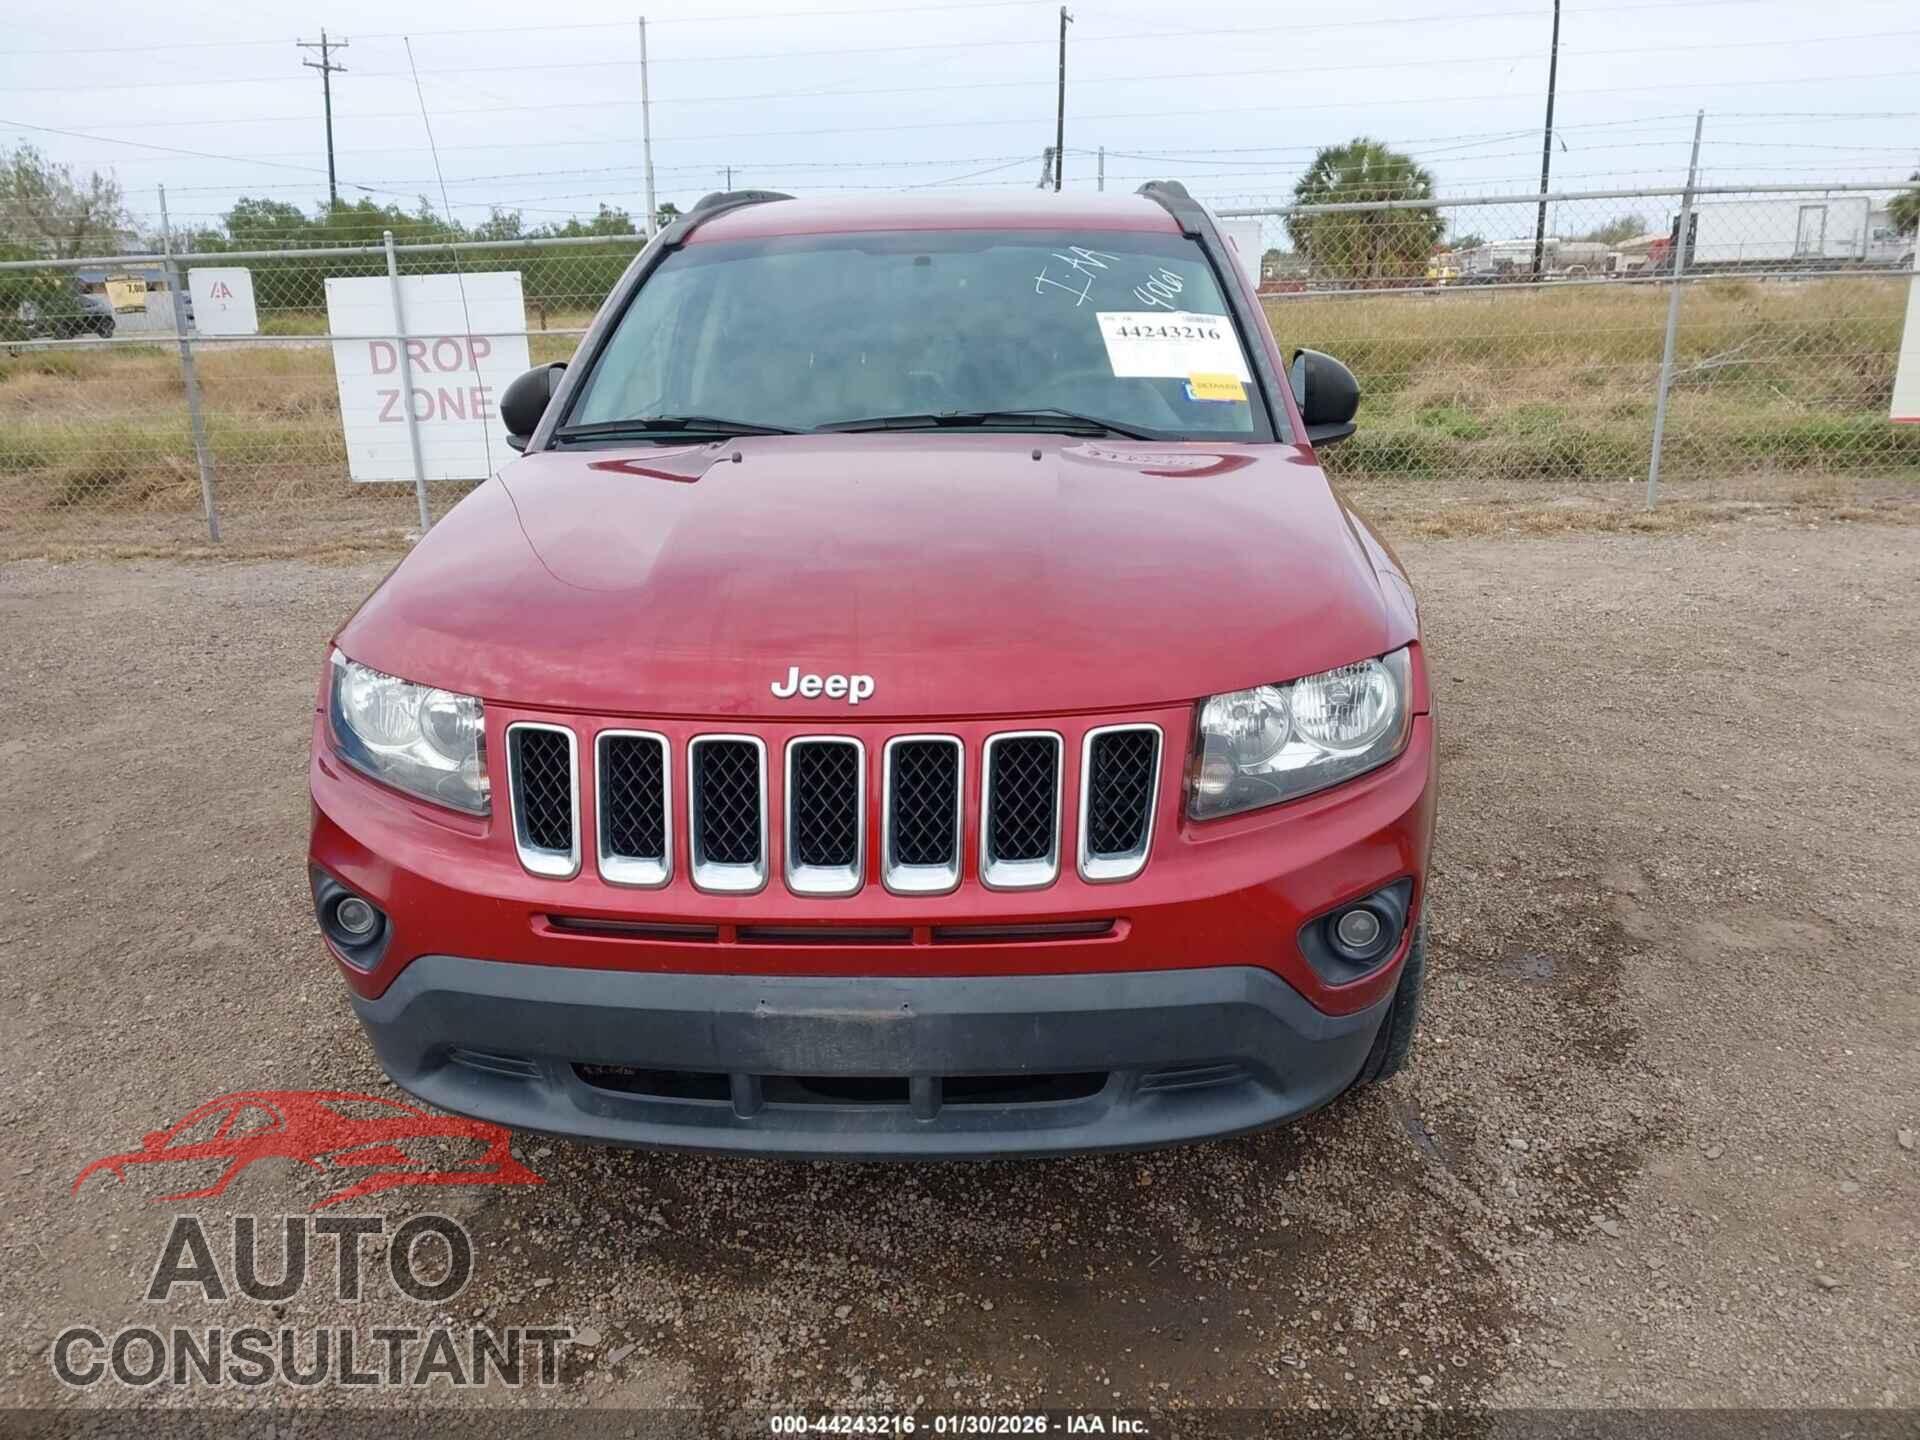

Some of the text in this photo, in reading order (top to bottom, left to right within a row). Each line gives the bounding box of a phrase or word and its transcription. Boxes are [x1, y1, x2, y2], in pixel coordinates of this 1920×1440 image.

[1115, 325, 1221, 340] 44243216
[368, 336, 492, 375] DROP
[376, 386, 497, 423] ZONE
[771, 666, 875, 704] Jeep
